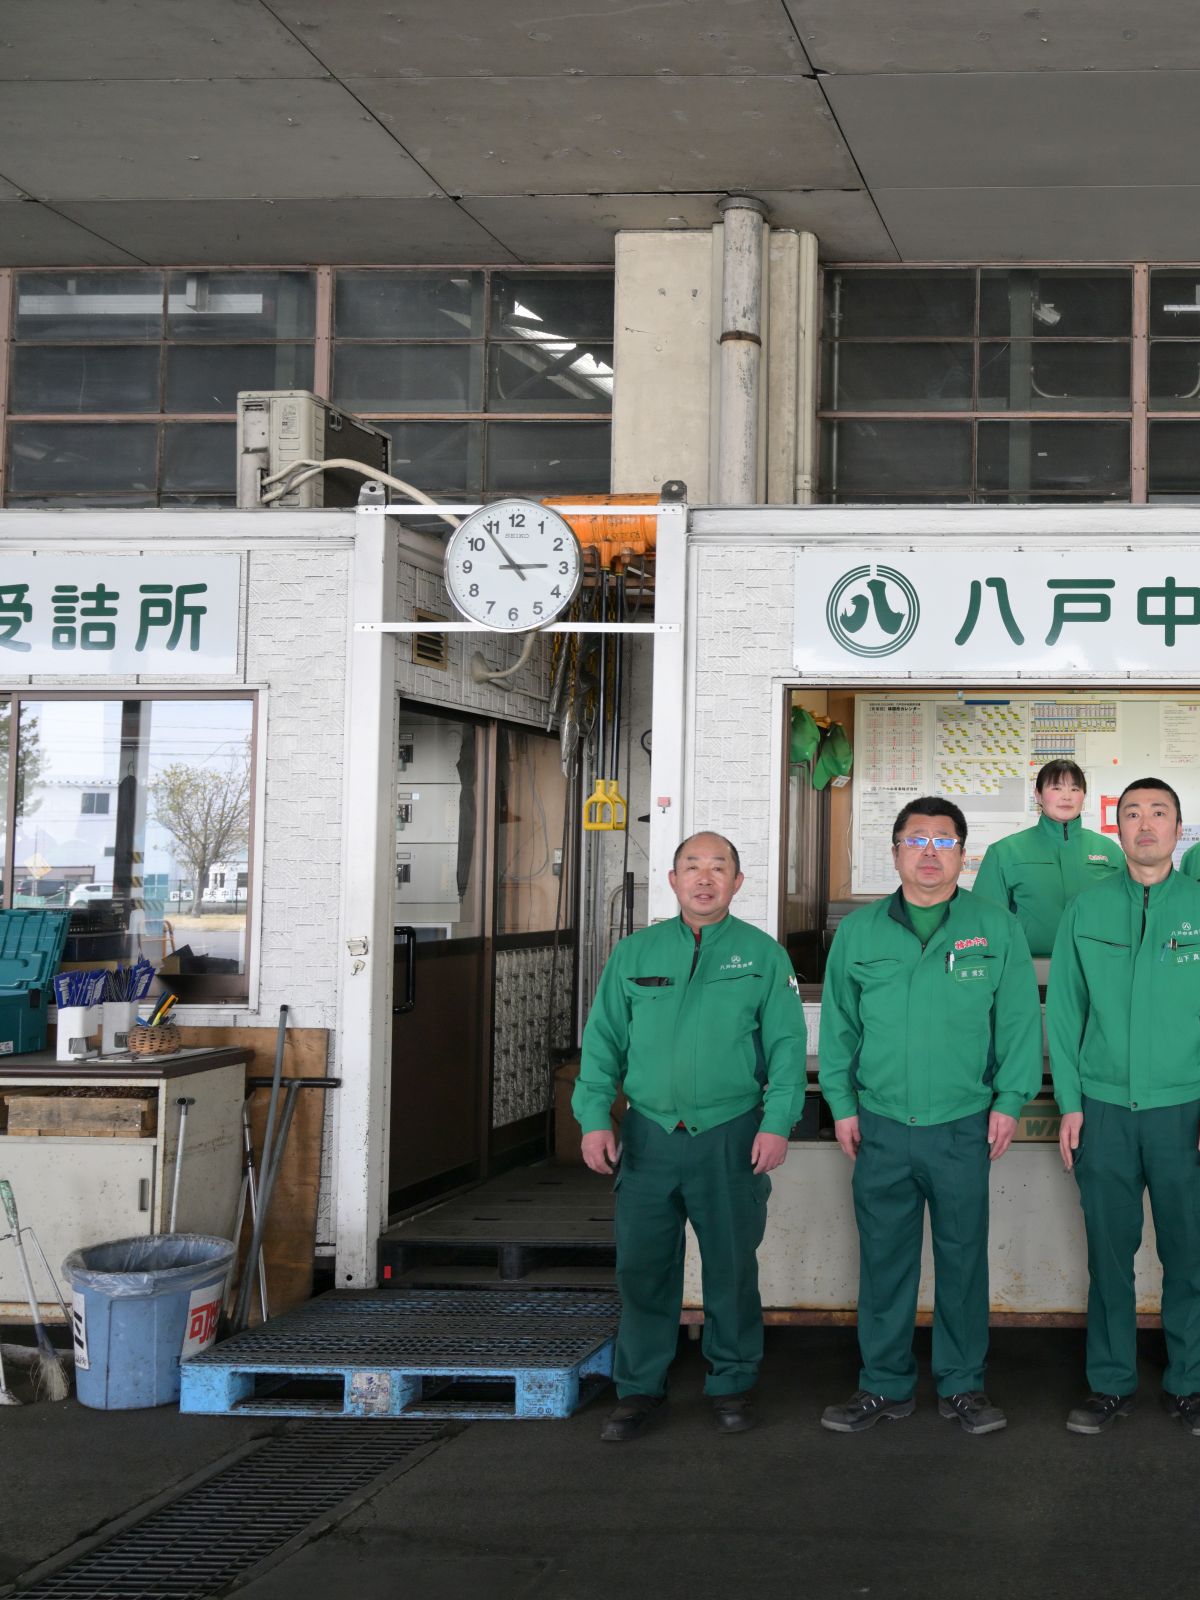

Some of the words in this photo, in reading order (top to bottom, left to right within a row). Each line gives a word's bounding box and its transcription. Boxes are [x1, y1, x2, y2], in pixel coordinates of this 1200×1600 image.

[509, 514, 525, 527] 12
[487, 521, 500, 534] 11
[538, 521, 544, 534] 1
[468, 538, 485, 551] 10
[553, 538, 563, 551] 2
[462, 560, 472, 573] 9
[559, 561, 569, 574] 3
[469, 584, 479, 597] 8
[550, 585, 561, 598] 4
[486, 601, 496, 614] 7
[508, 608, 518, 620] 6
[533, 602, 543, 615] 5
